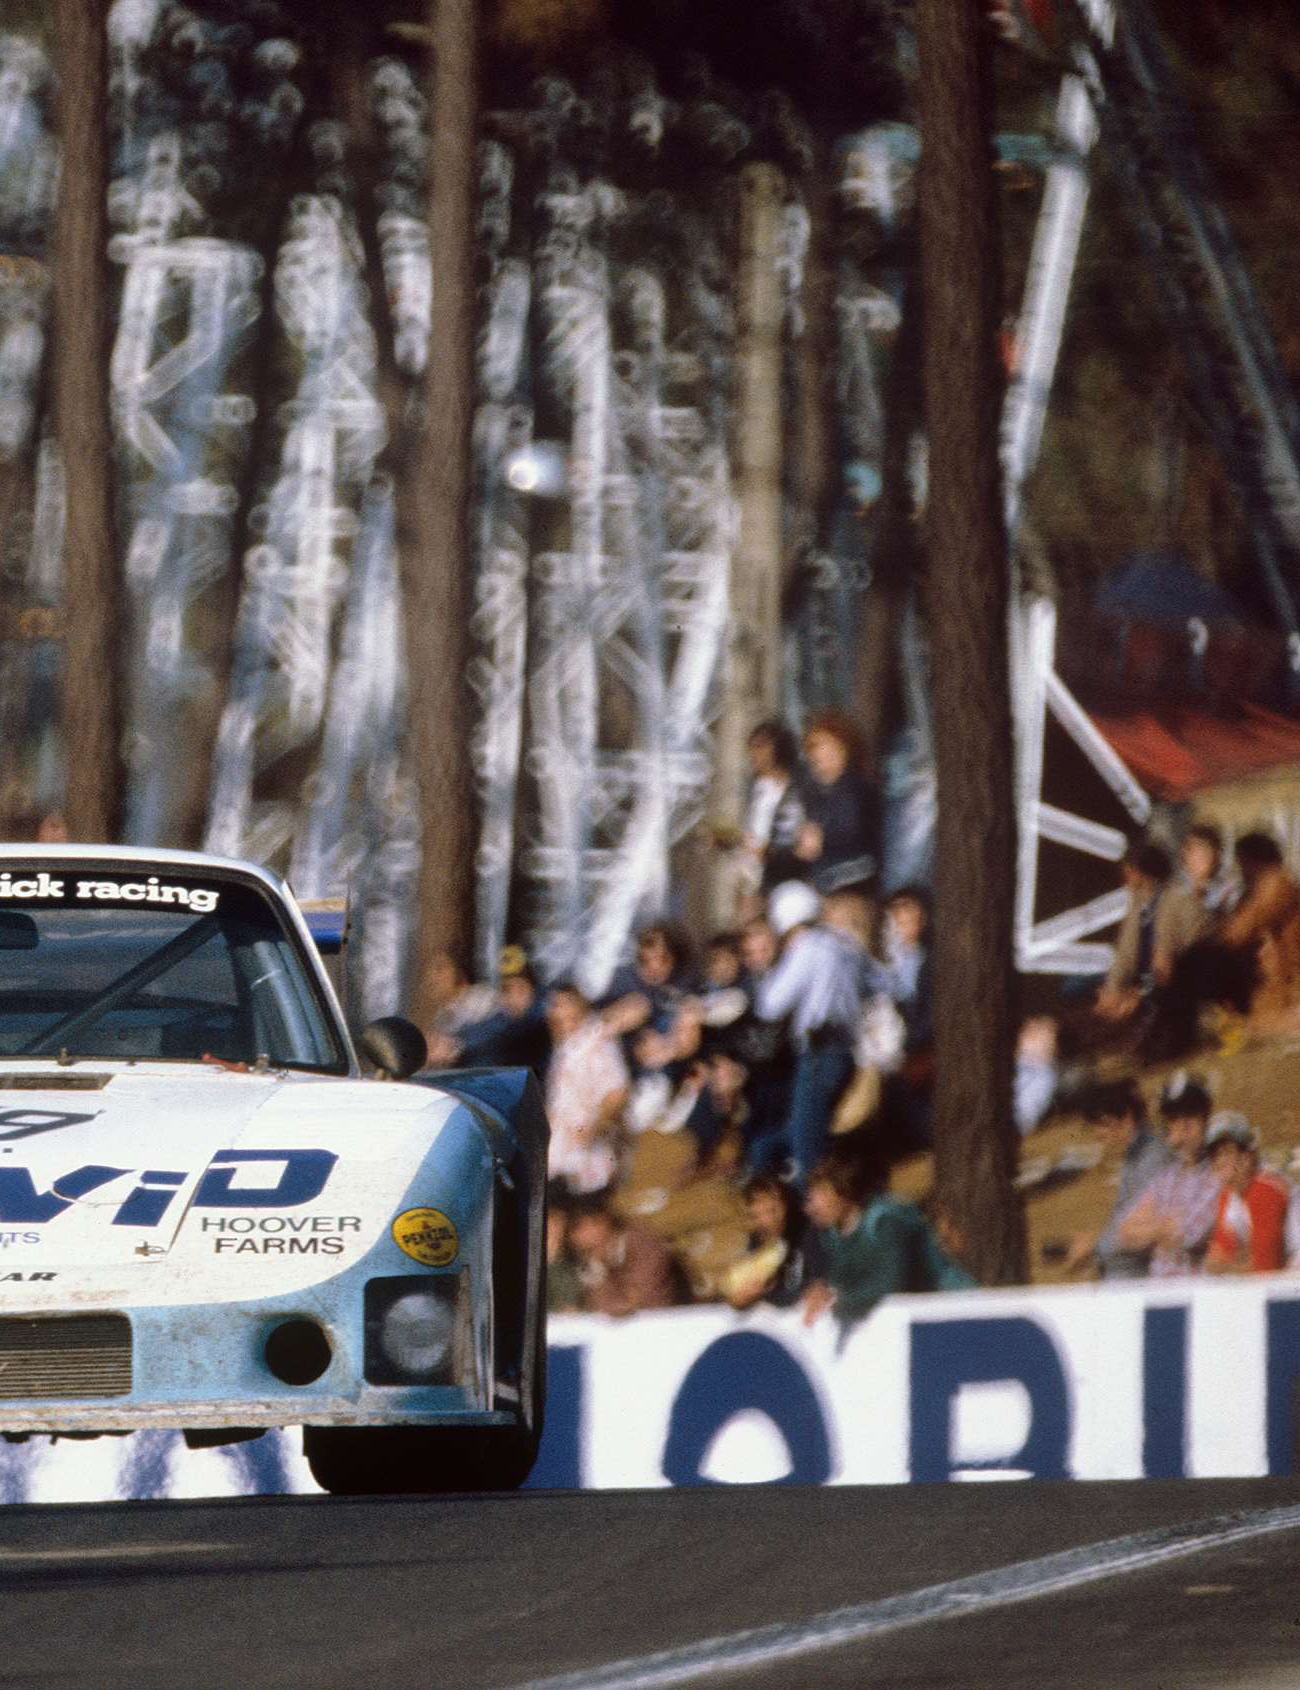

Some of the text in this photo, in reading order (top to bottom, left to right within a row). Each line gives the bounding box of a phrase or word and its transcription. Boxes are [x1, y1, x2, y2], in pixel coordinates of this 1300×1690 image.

[76, 877, 220, 912] racing
[201, 1216, 362, 1233] HOOVER
[214, 1237, 345, 1254] FARMS
